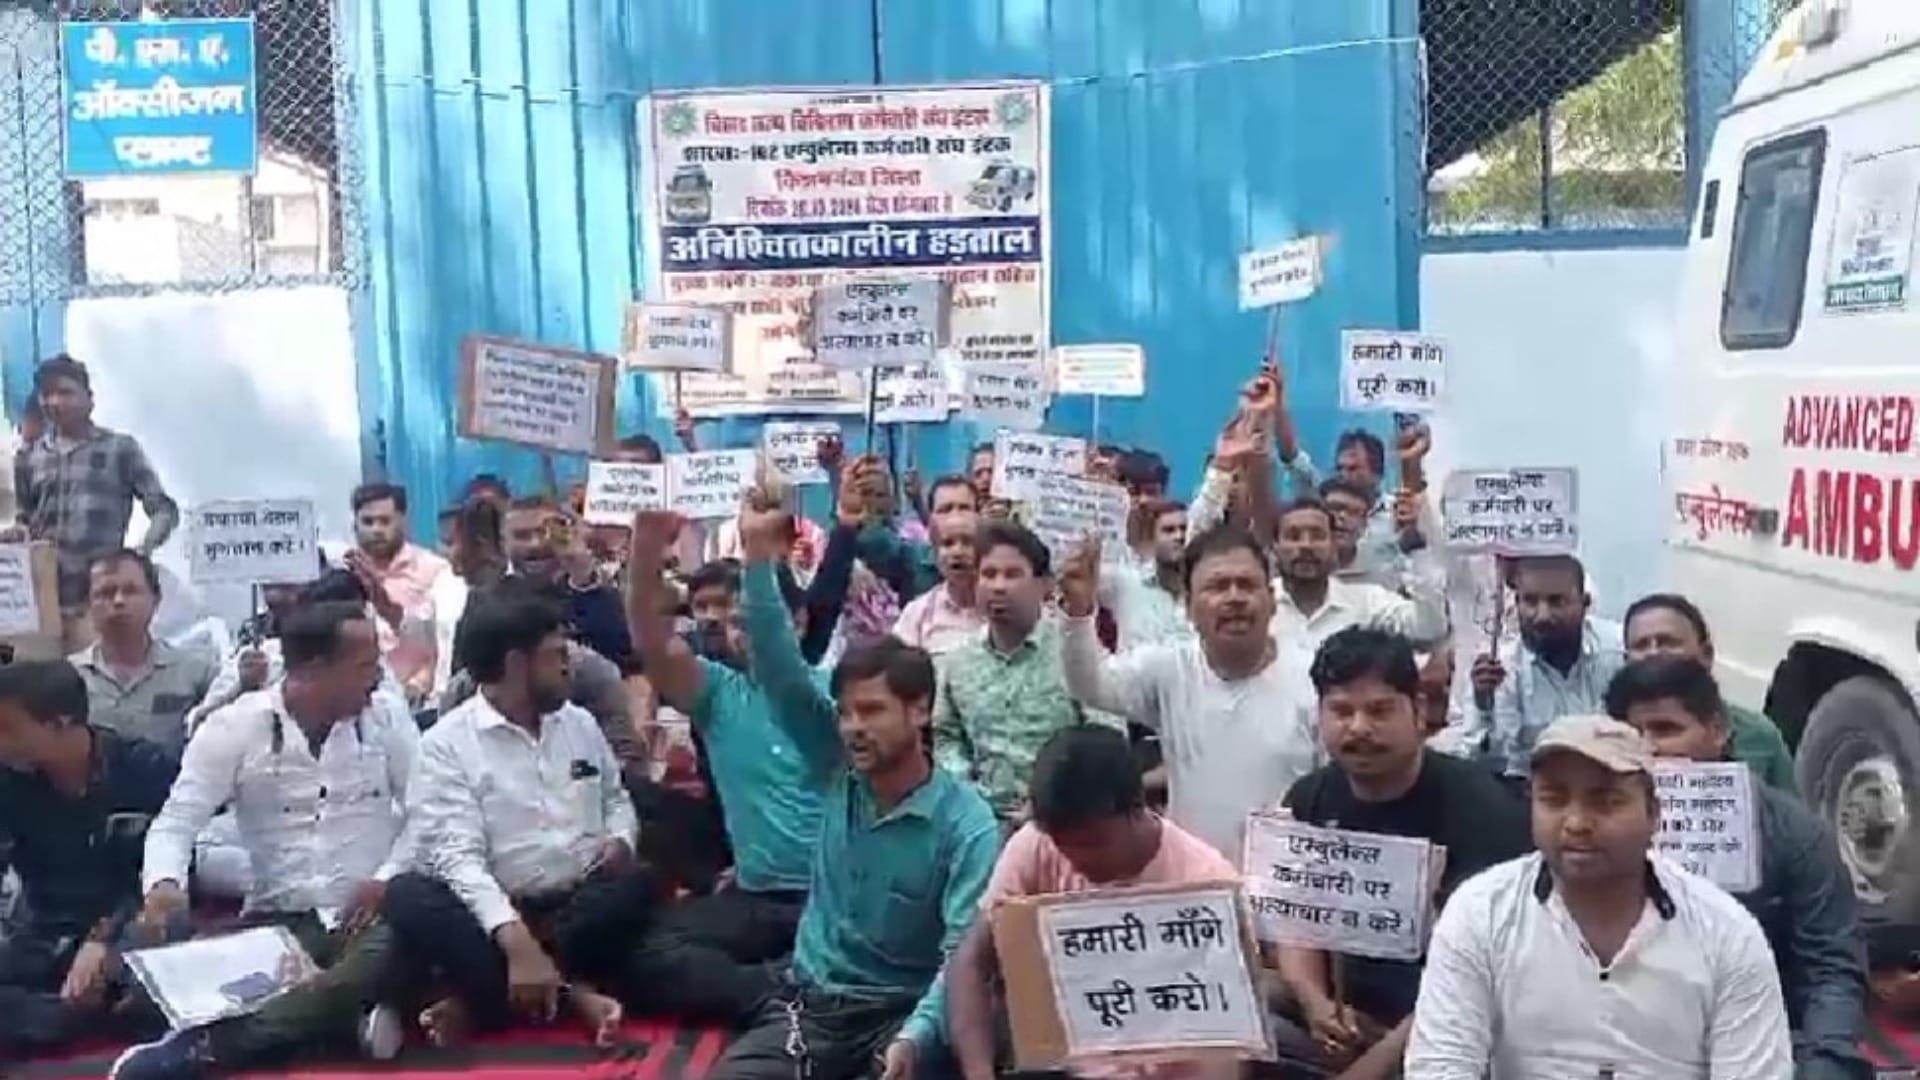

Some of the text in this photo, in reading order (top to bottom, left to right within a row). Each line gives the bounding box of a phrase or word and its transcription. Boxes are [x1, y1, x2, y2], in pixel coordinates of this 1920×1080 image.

[669, 225, 1034, 265] अनिश्चितकालीन हड़ताल
[1351, 339, 1402, 362] हमारी
[1782, 396, 1915, 454] ADVANCED
[1781, 468, 1920, 571] AMBU
[1363, 878, 1393, 900] पर
[1058, 912, 1148, 958] हमारी
[1084, 979, 1136, 1028] पूरी
